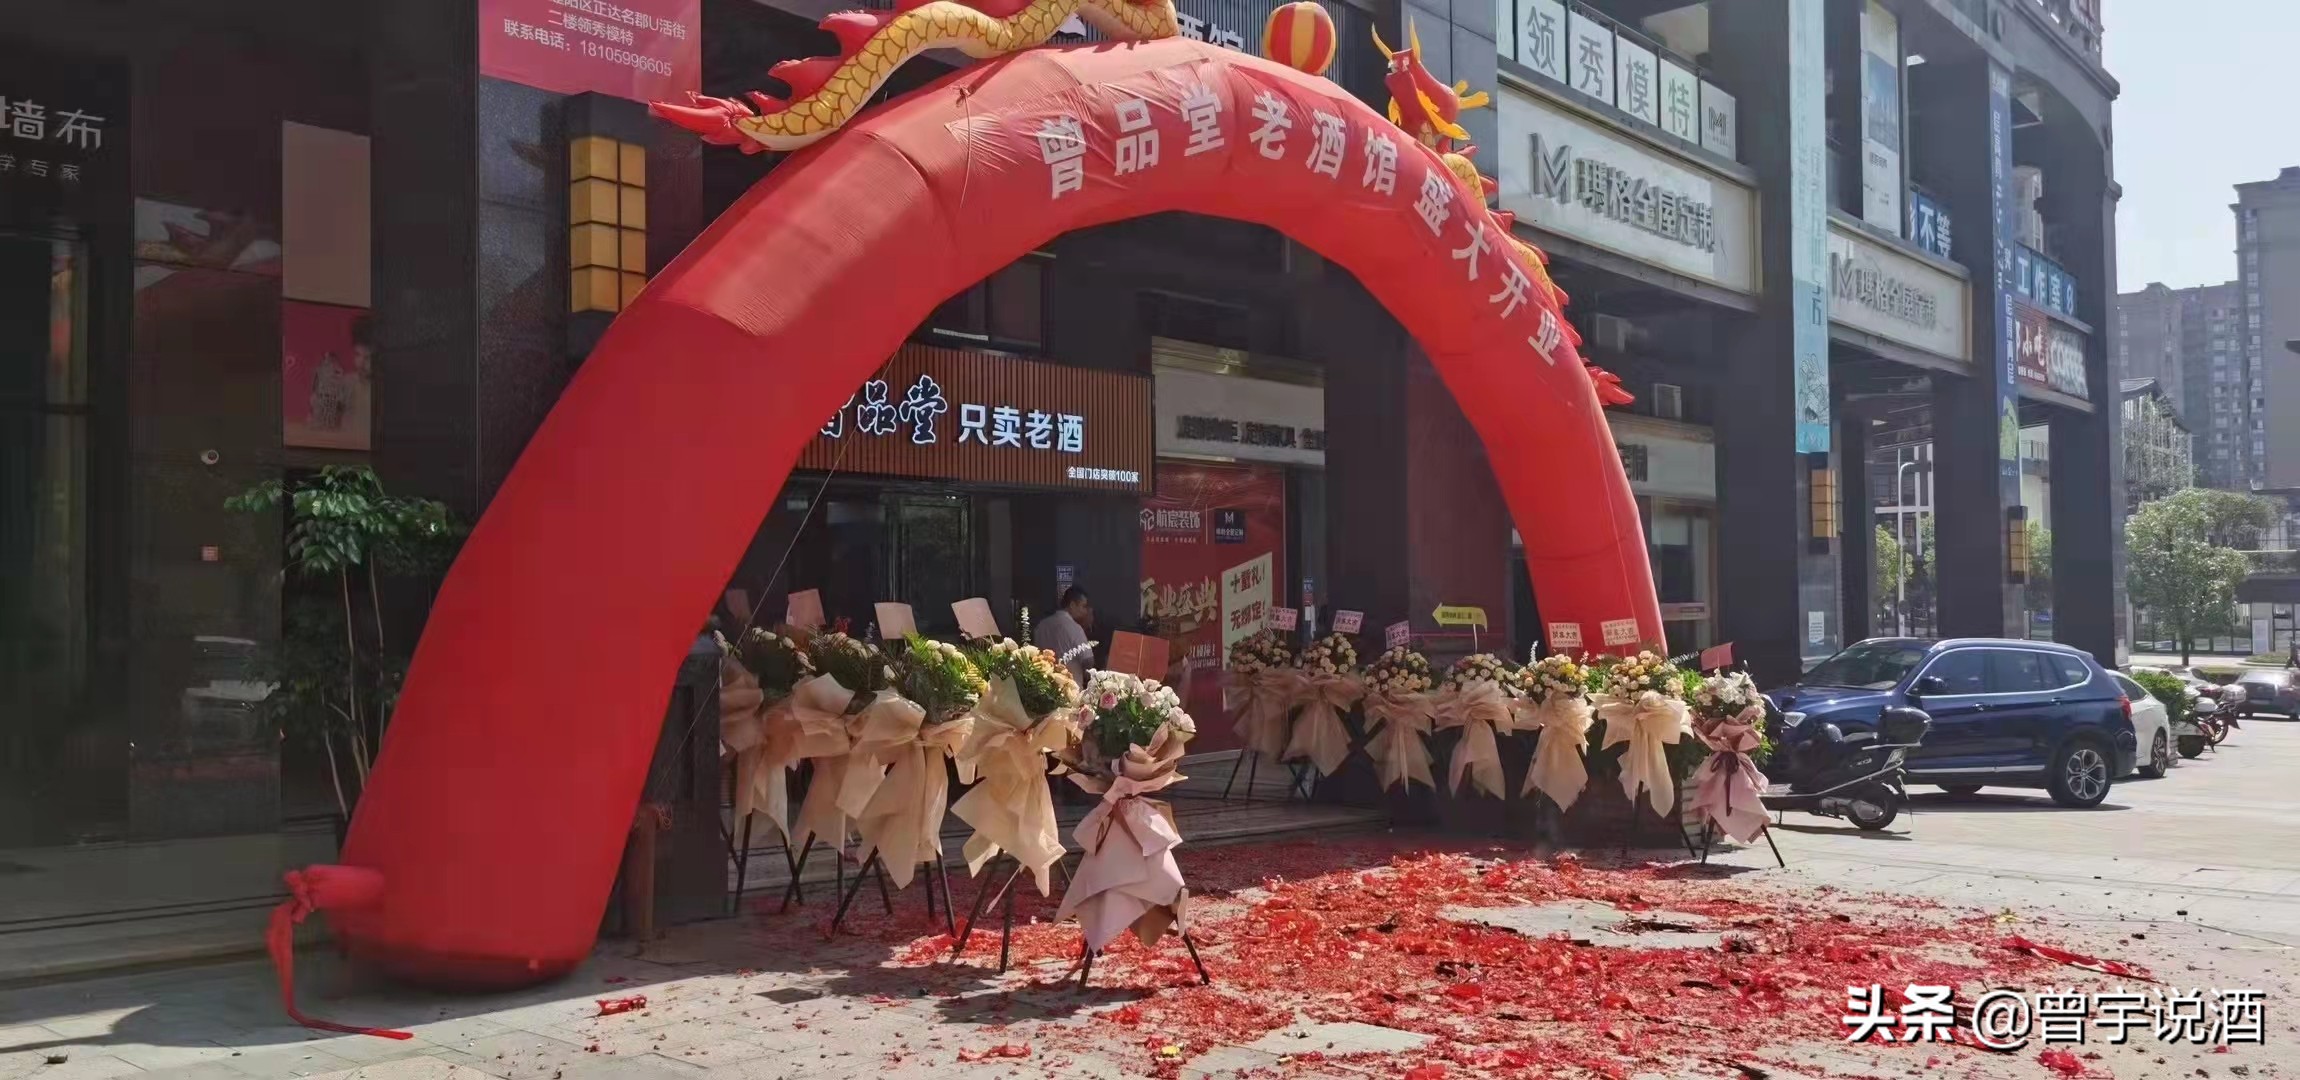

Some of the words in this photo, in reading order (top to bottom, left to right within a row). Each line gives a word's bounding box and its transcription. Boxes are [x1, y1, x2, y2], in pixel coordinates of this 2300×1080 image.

[548, 9, 634, 46] 二楼领秀模特
[1526, 5, 1691, 137] 领秀模特
[1036, 82, 1563, 368] 曾品堂老酒馆盛大开业
[956, 402, 1084, 453] 只卖老酒
[1066, 465, 1140, 484] 全国门店突破100家
